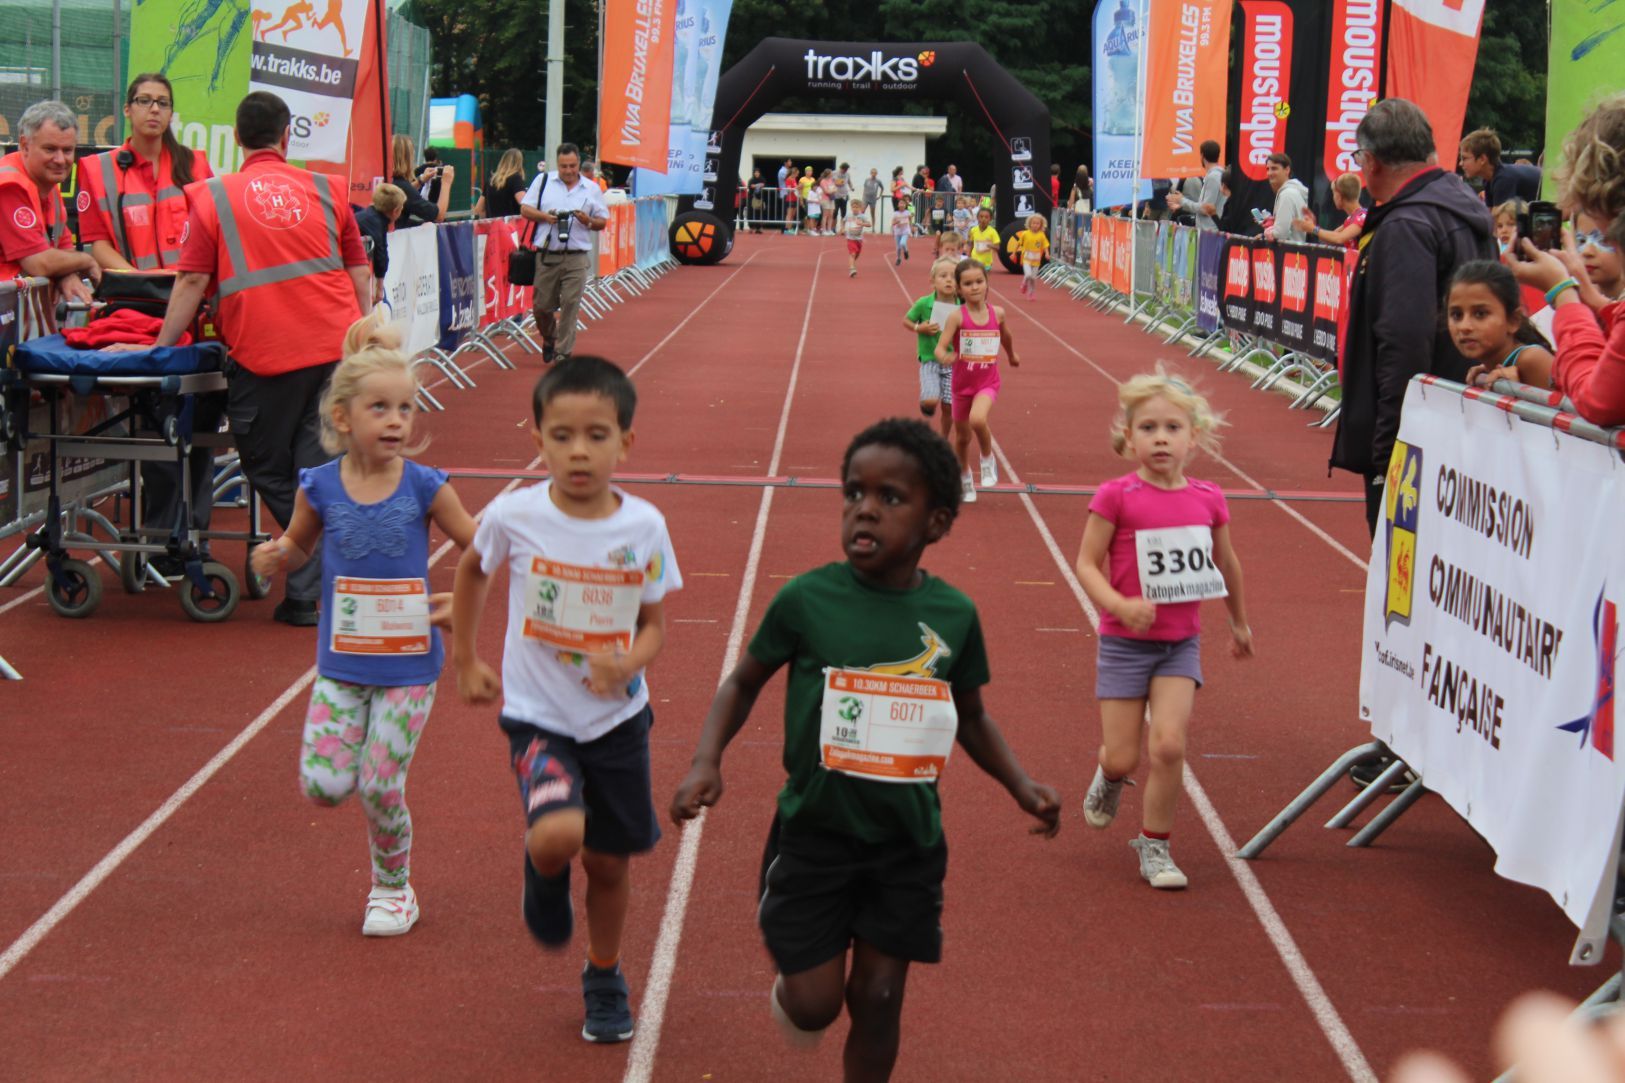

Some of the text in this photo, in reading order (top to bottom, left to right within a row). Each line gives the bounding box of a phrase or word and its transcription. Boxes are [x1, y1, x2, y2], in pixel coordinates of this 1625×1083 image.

[625, 0, 653, 103] BRUXELLE
[804, 49, 918, 81] trakks
[808, 82, 842, 90] running
[882, 82, 917, 90] outdoor
[1240, 14, 1282, 166] moustique
[1326, 0, 1377, 172] moustique
[1172, 108, 1193, 155] VIVA
[251, 180, 302, 221] H H T
[1437, 464, 1534, 560] COMMISSION
[889, 681, 937, 696] SCHAERBEEK
[889, 701, 924, 722] 6071
